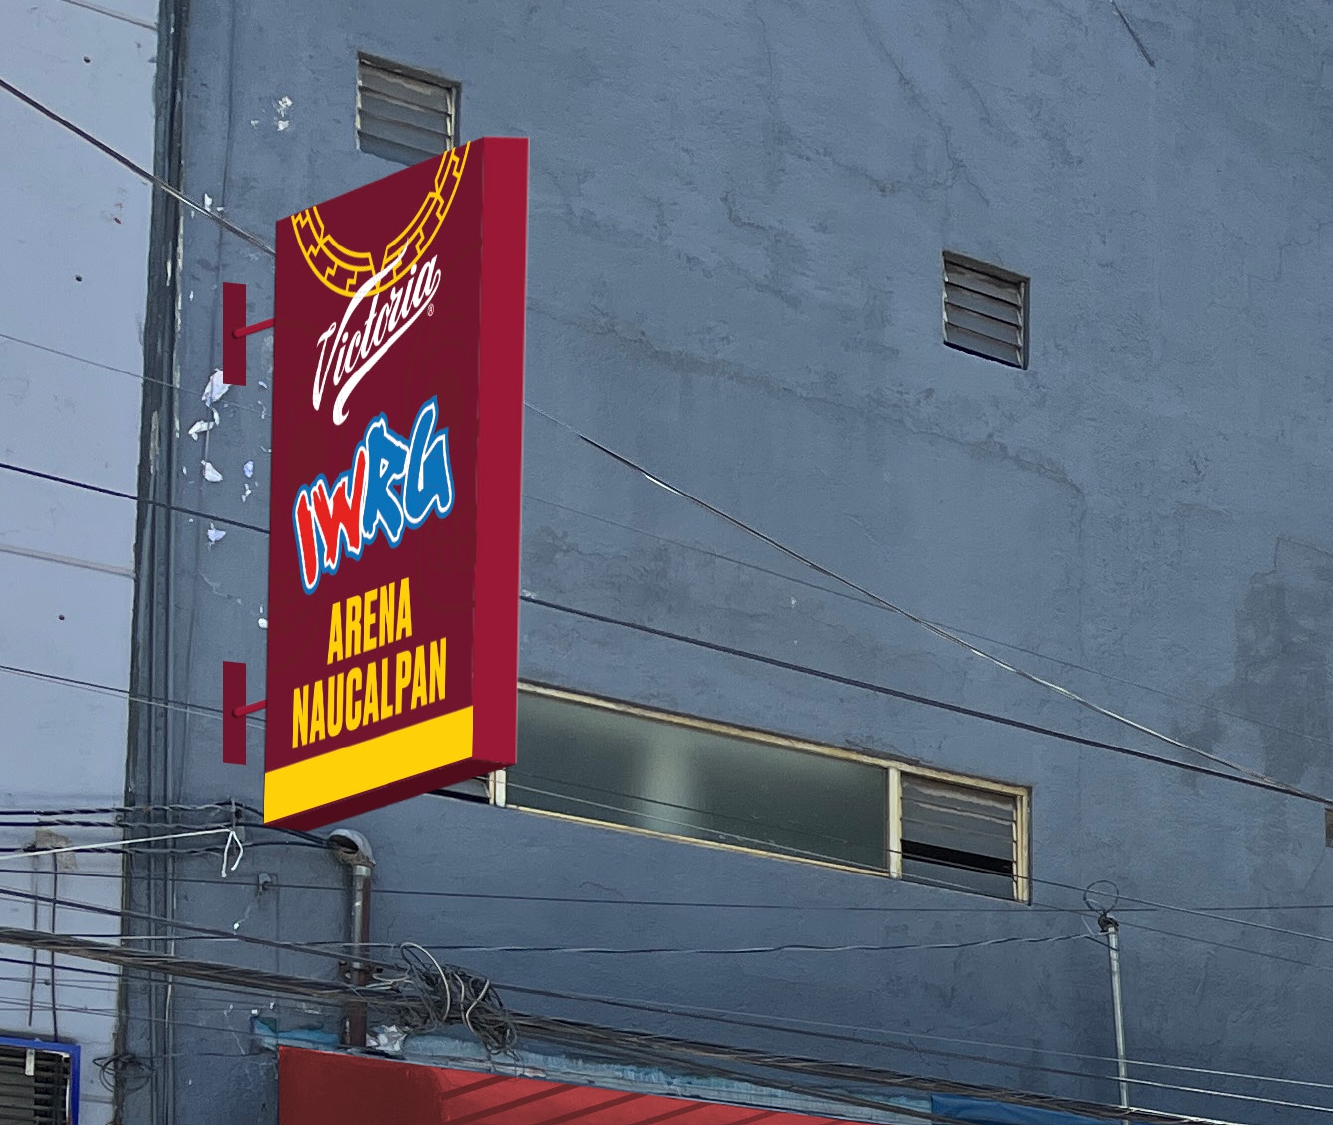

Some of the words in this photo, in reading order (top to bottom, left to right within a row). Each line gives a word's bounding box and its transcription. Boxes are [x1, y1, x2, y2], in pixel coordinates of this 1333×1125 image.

[312, 239, 442, 425] Victoria
[292, 395, 456, 595] IWRG
[292, 638, 448, 749] NAUCALPAN
[327, 577, 413, 665] ARENA
